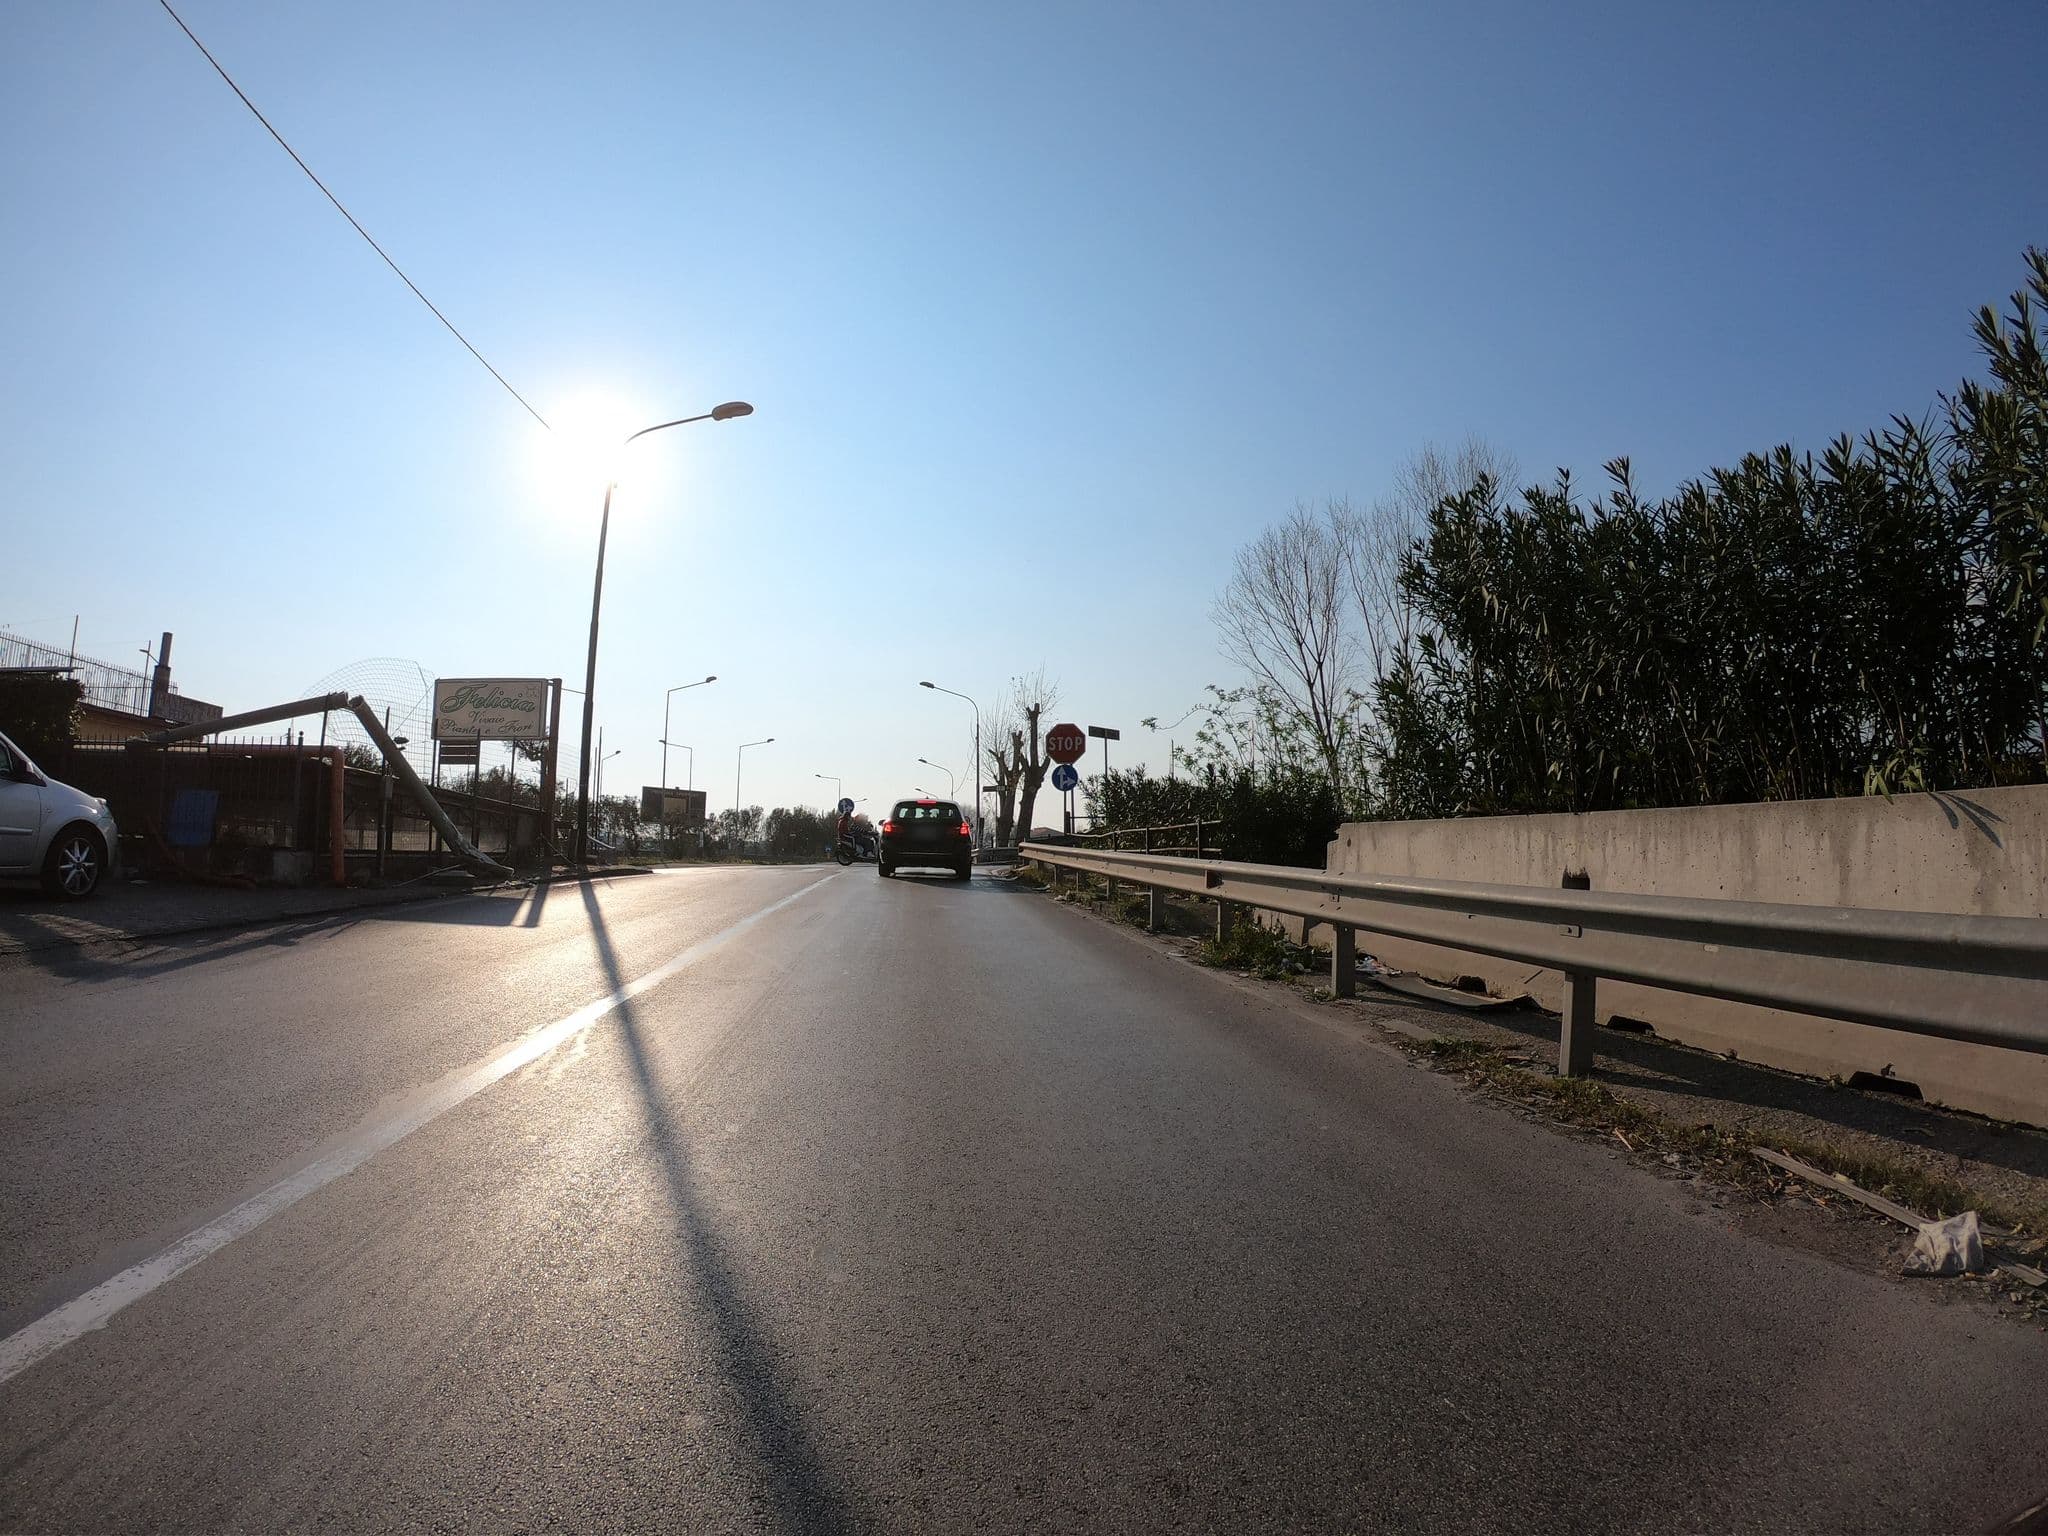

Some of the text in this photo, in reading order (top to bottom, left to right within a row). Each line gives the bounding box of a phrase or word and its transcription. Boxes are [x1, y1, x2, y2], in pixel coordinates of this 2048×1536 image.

[440, 683, 535, 713] Felicia
[468, 710, 504, 724] Vivaio
[440, 719, 479, 734] Piante
[498, 720, 532, 734] Fiori
[1049, 736, 1082, 751] STOP
